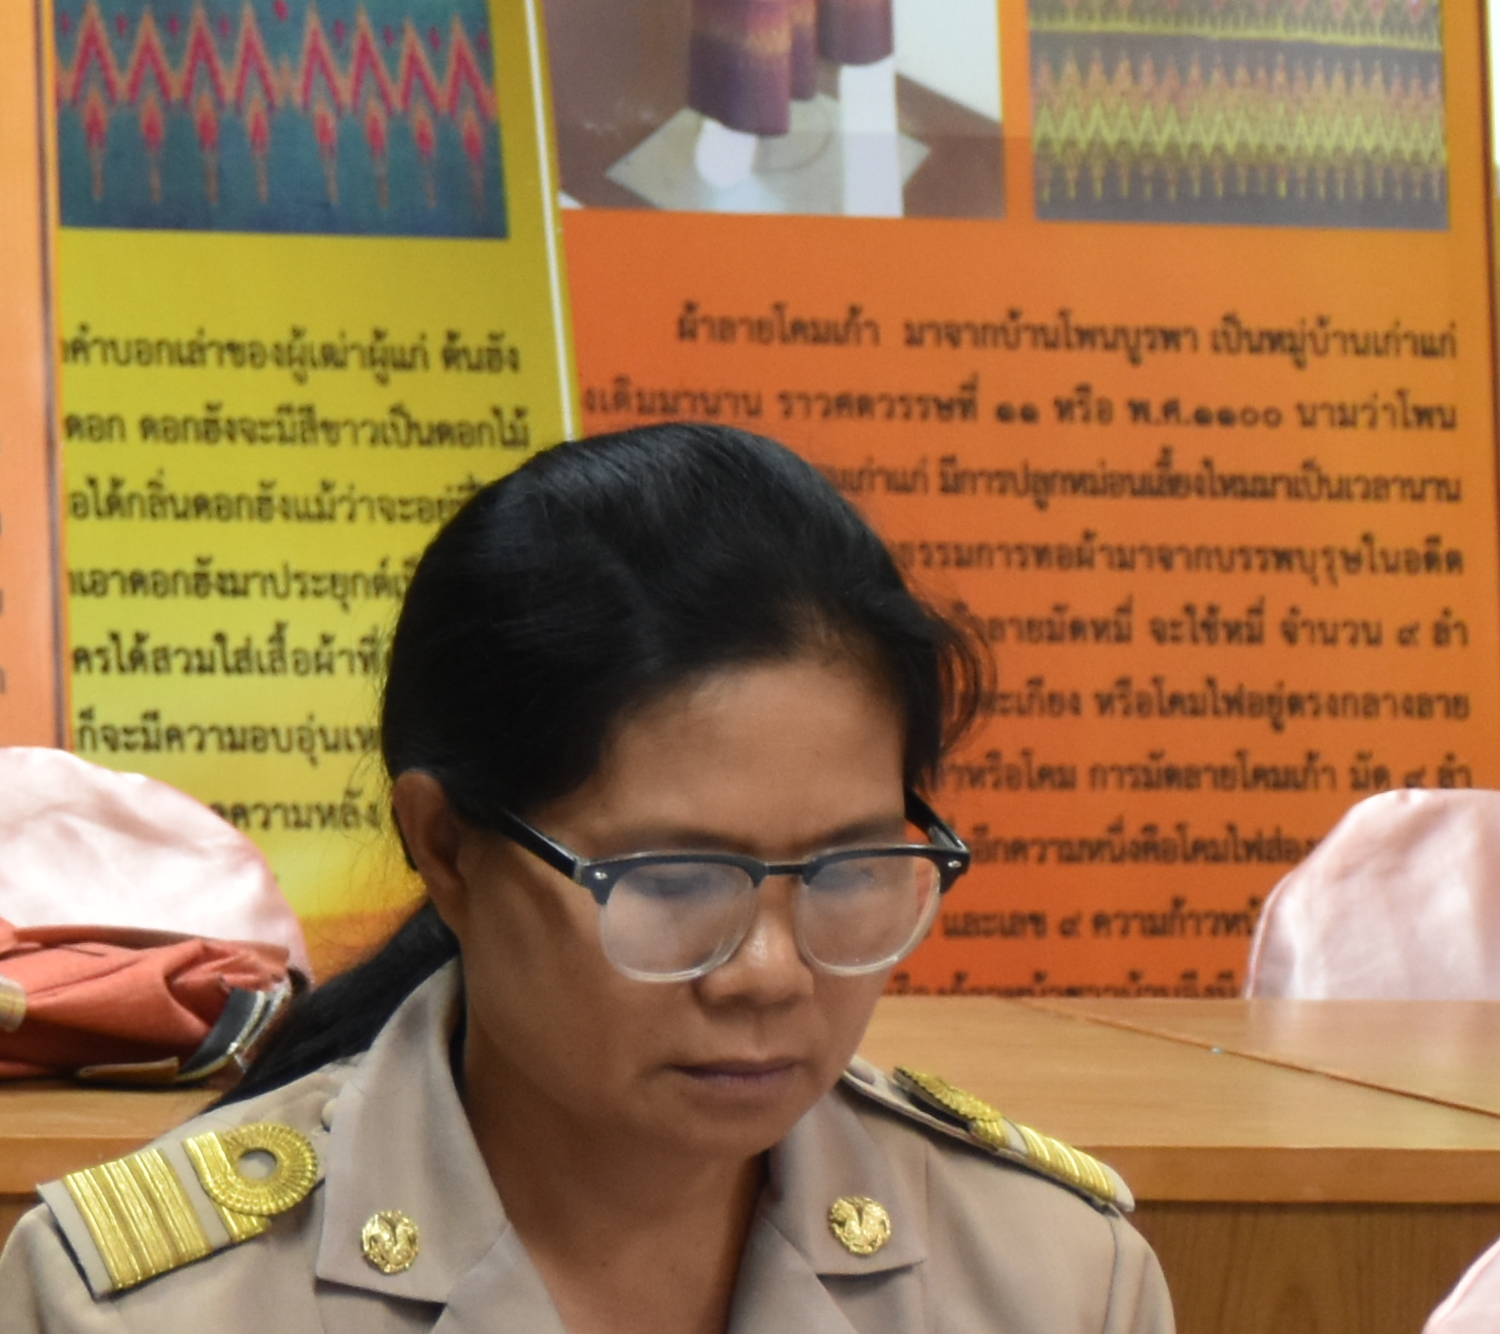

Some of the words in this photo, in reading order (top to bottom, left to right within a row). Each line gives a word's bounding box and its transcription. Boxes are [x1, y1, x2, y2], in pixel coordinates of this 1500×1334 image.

[60, 323, 430, 385] คำบอกเล่าของผู้เฒ่าผู้แก่
[678, 300, 881, 347] ผ้าลายโคมเก้า
[1212, 311, 1457, 370] เป็นหมู่บ้านเก่าแก่
[1054, 383, 1114, 425] หรือ
[1281, 609, 1382, 648] จำนวน
